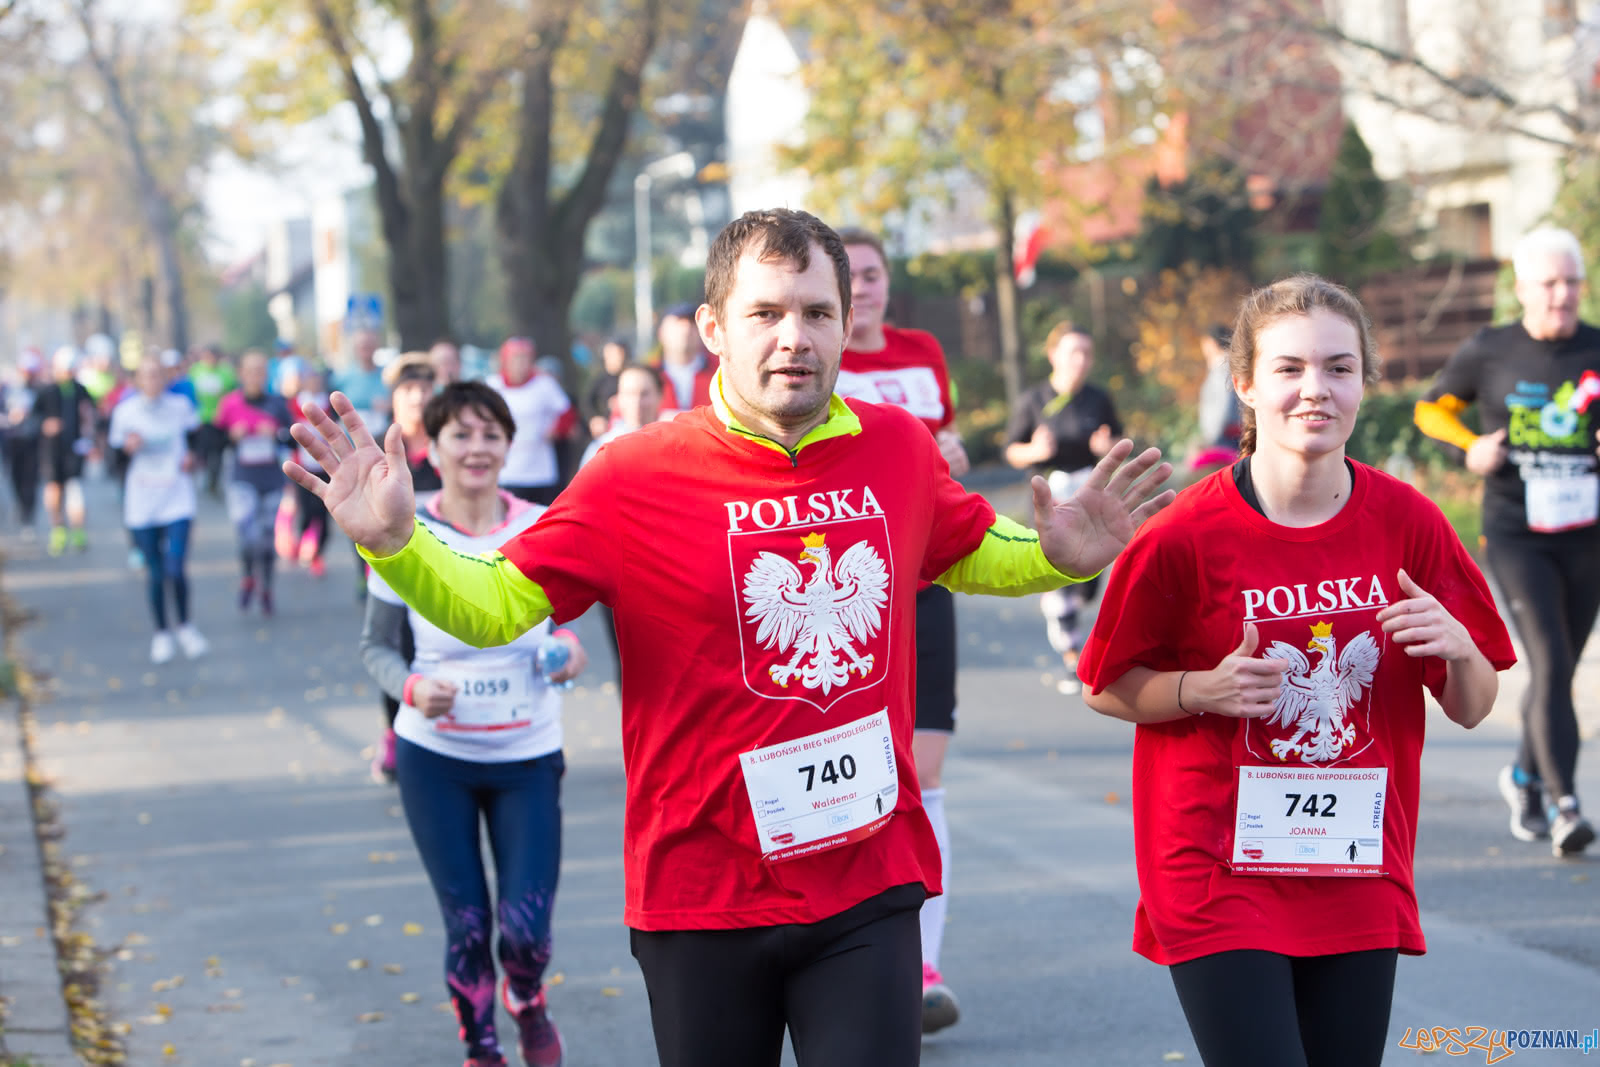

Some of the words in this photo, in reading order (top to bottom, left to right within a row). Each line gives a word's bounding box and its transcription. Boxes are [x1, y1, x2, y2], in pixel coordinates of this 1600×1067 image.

[724, 485, 885, 532] POLSKA
[1241, 574, 1389, 620] POLSKA
[464, 679, 509, 696] 1059
[750, 756, 758, 764] 8.
[759, 744, 802, 762] LUBOŃSKI
[803, 739, 822, 750] BIEG
[823, 718, 883, 745] NIEPODLEGŁOŚCI
[798, 754, 857, 791] 740
[884, 743, 895, 774] STREFA
[1247, 771, 1254, 779] 8.
[1256, 770, 1296, 780] LUBOŃSKI
[1317, 771, 1380, 781] NIEPODLEGŁOŚCI
[812, 792, 857, 810] Waldemar
[1285, 793, 1338, 817] 742
[1373, 800, 1382, 829] STREFA
[1289, 827, 1327, 836] JOANNA
